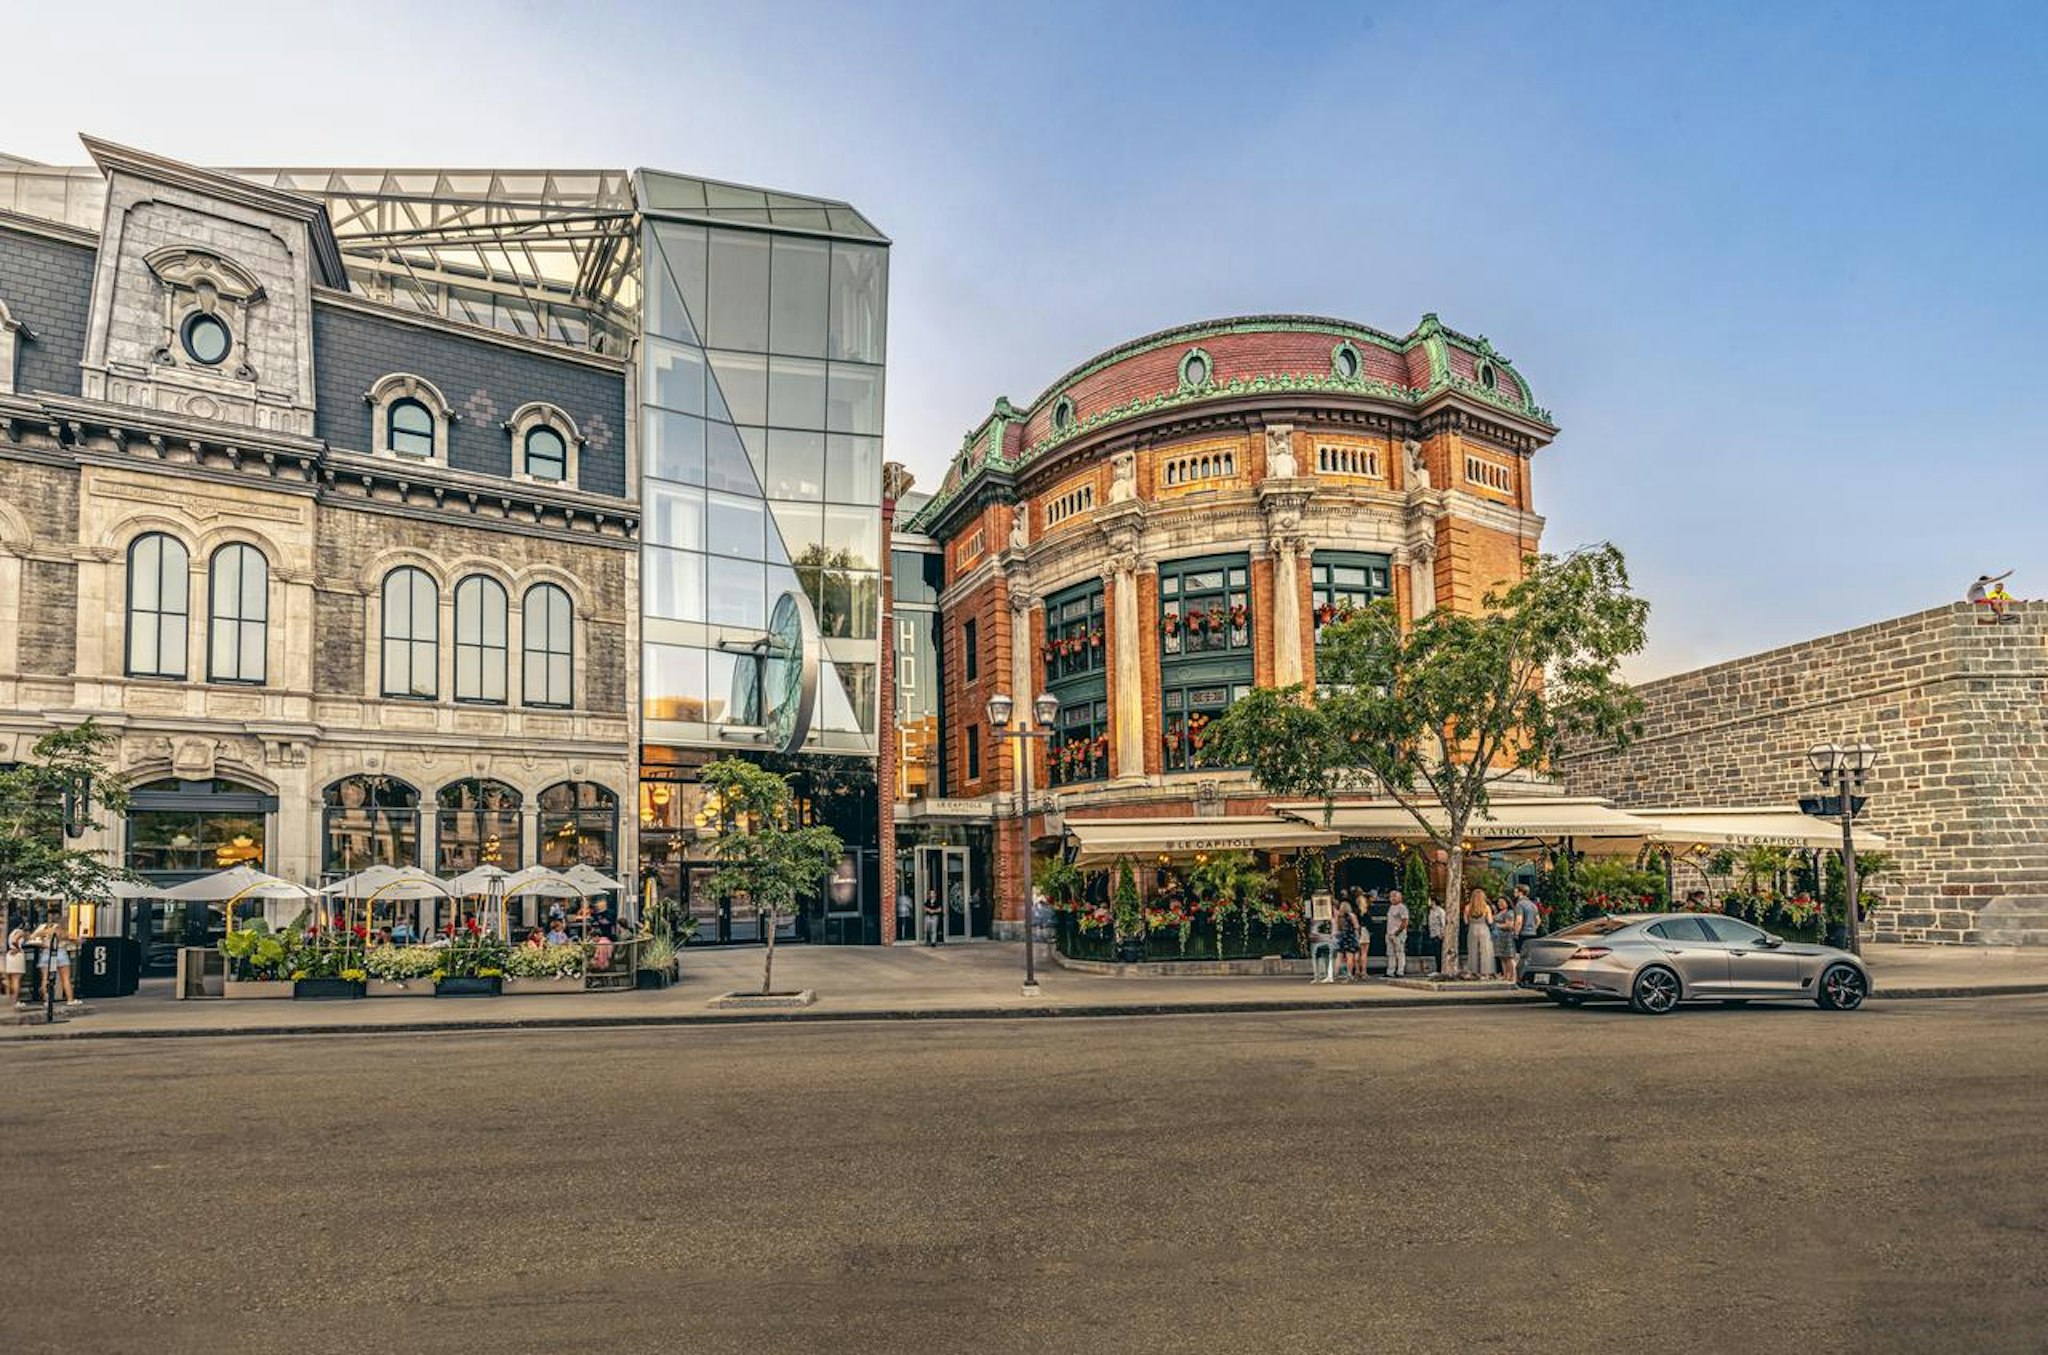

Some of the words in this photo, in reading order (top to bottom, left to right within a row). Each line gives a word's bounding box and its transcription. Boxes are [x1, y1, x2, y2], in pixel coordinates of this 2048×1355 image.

[1468, 827, 1526, 836] TEATRO
[1178, 840, 1190, 849] LE
[1196, 839, 1256, 848] CAPITOLE
[1737, 835, 1749, 844] LE
[1753, 836, 1808, 846] CAPITOLE
